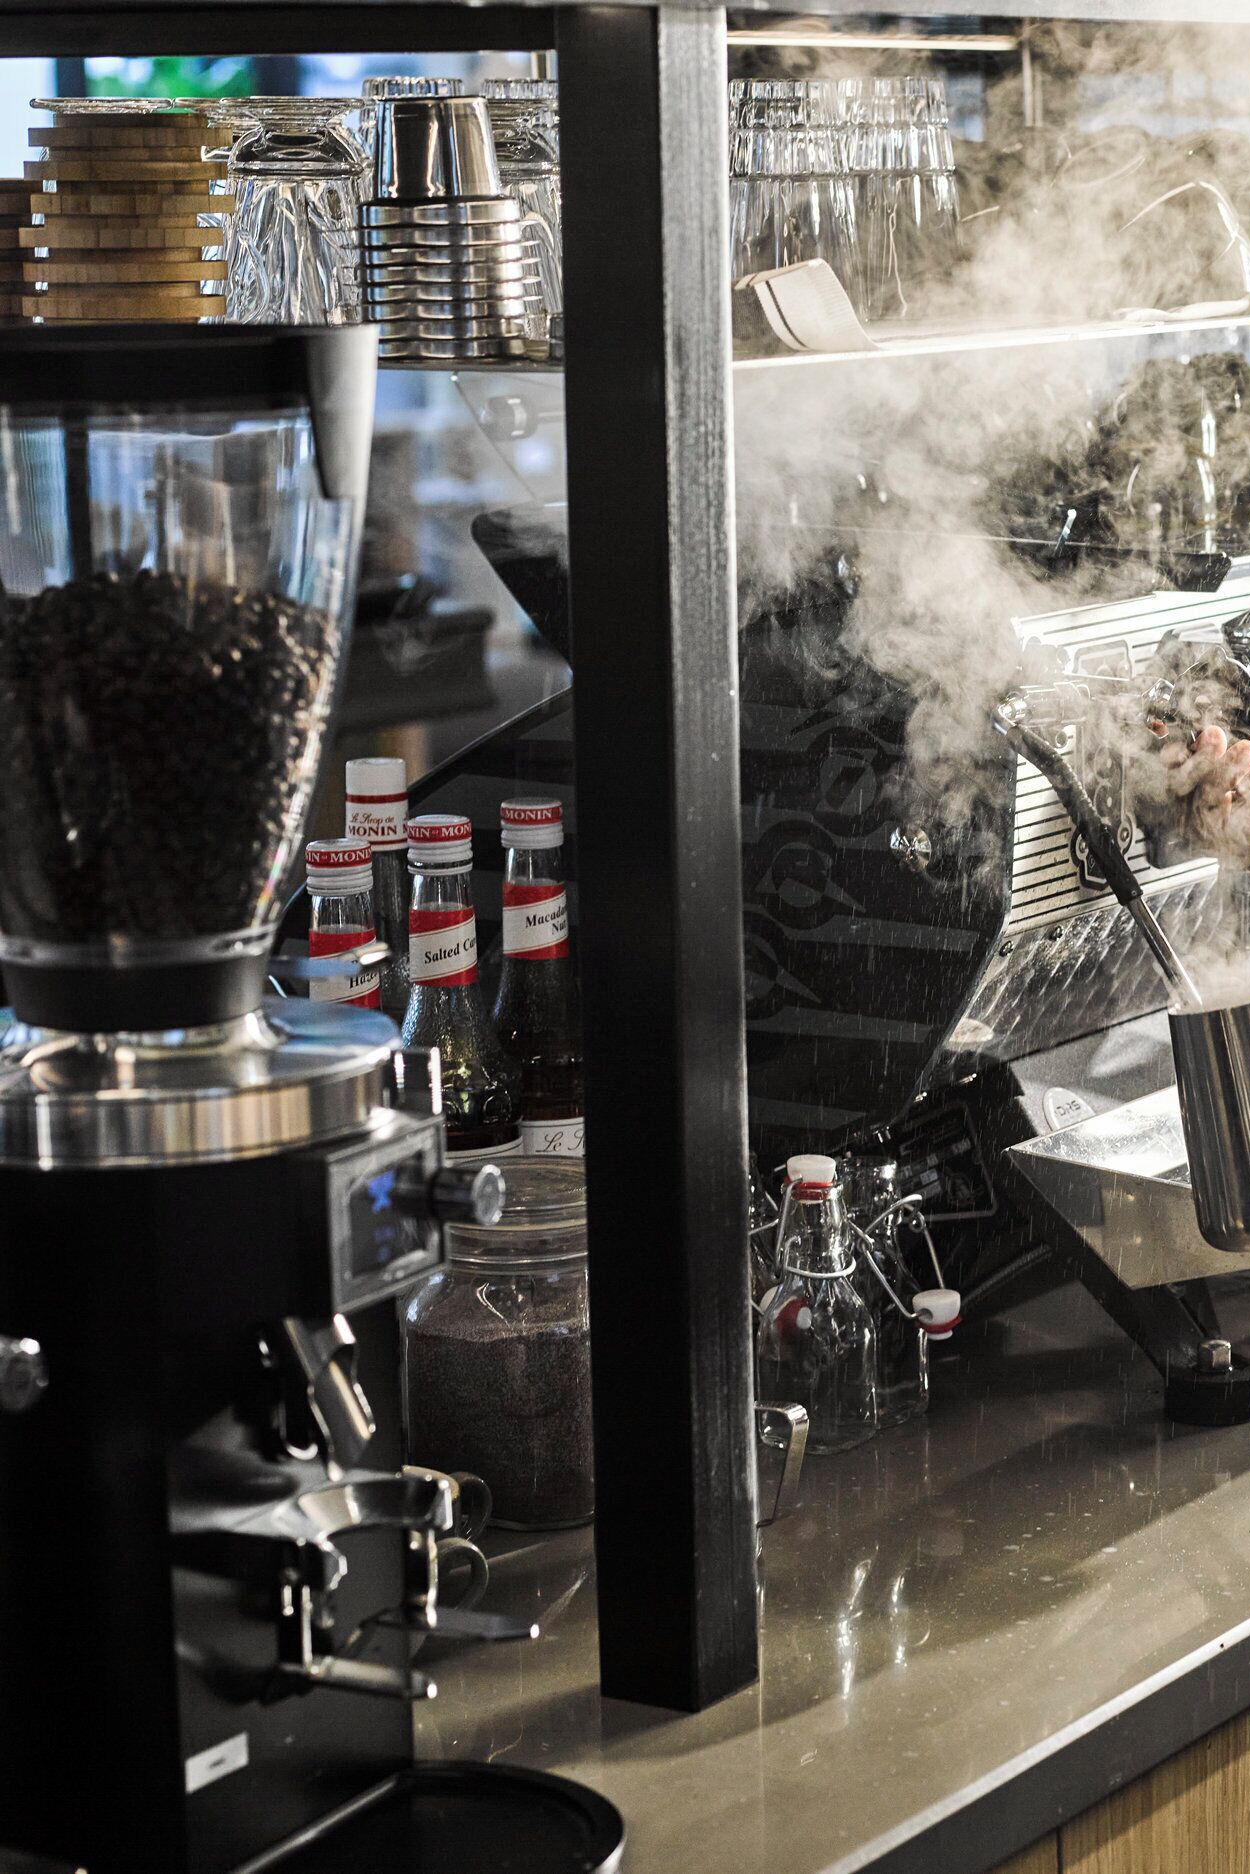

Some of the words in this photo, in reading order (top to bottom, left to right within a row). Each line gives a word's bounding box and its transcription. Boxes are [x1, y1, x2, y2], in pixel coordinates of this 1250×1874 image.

[504, 808, 553, 820] MONIN
[348, 824, 398, 837] MONIN
[424, 942, 460, 965] Salted
[535, 1131, 564, 1153] Le
